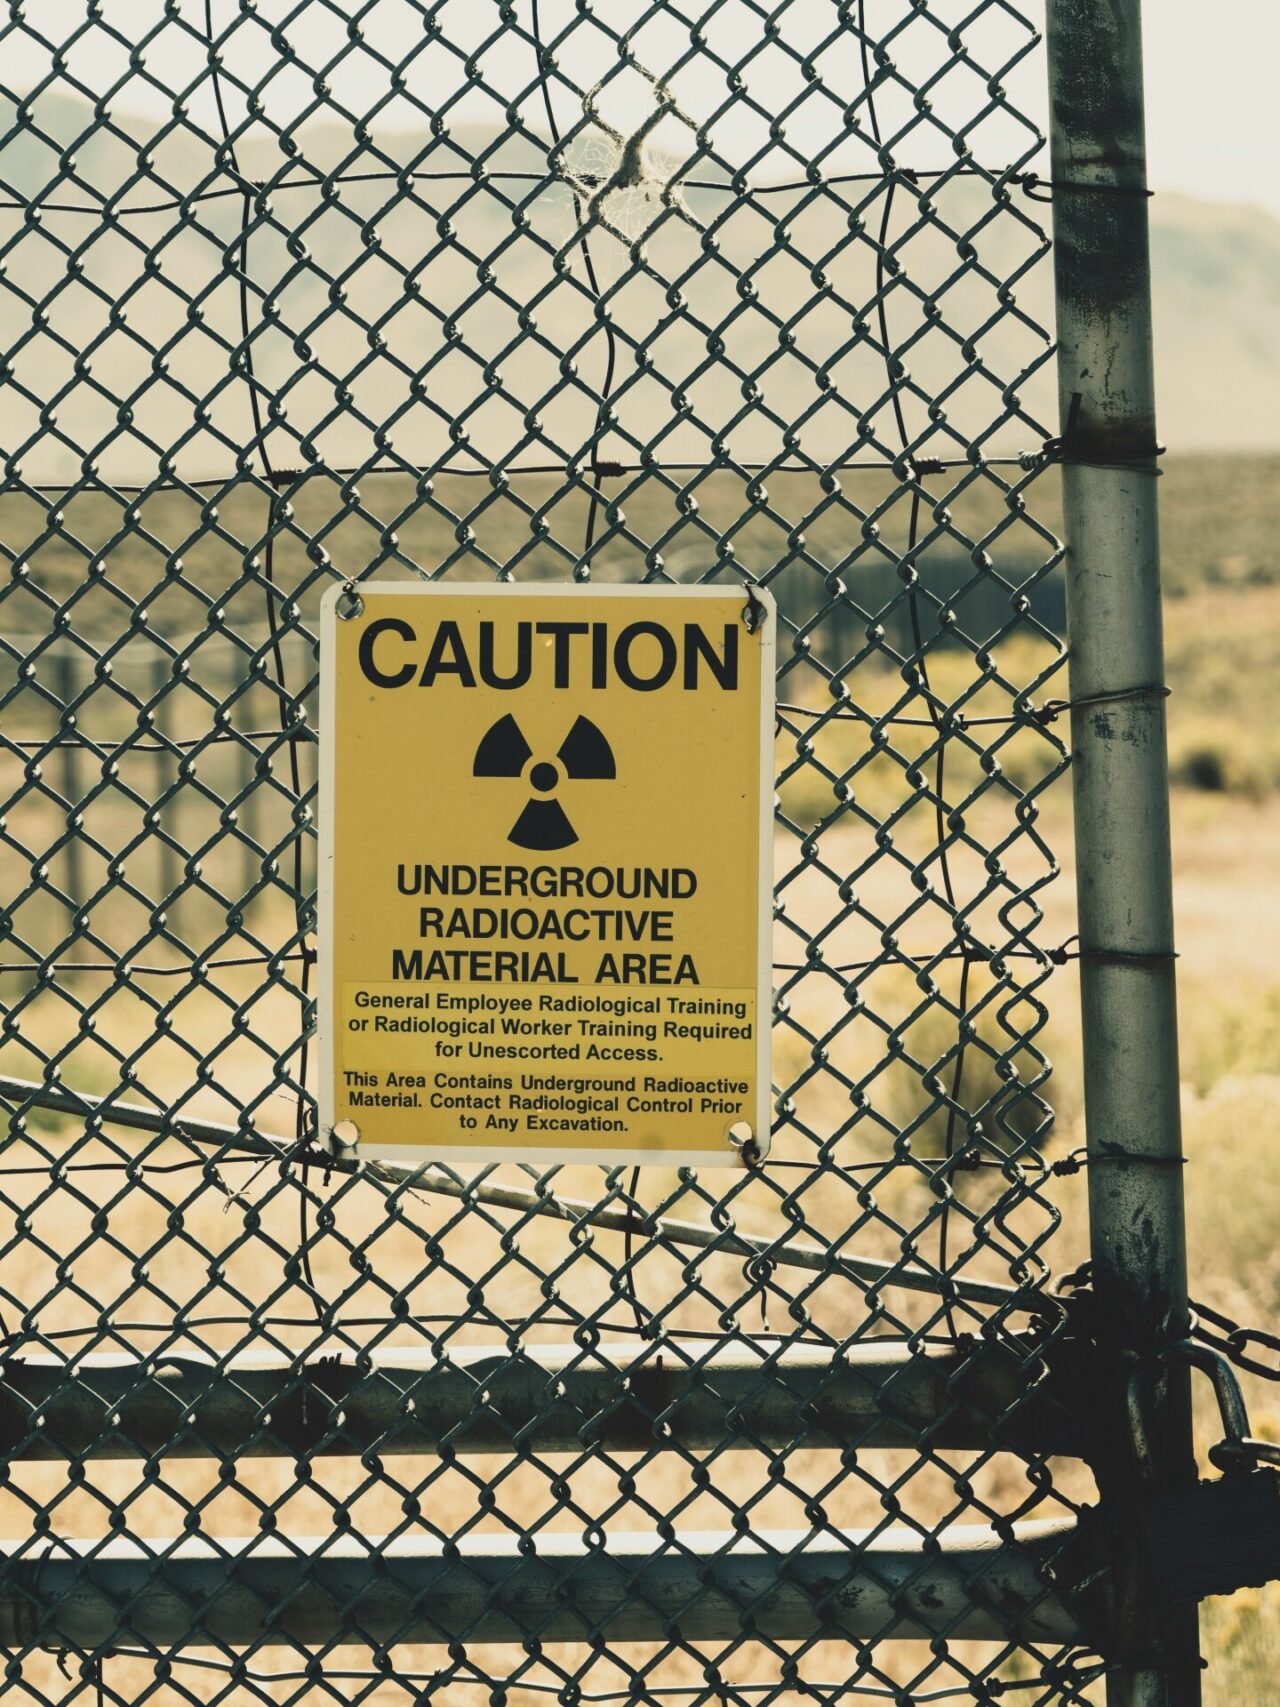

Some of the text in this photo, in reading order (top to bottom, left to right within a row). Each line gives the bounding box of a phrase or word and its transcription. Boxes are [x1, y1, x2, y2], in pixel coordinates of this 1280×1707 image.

[359, 618, 738, 692] CAUTION
[398, 864, 697, 899] UNDERGROUND
[420, 907, 673, 941] RADIOACTIVE
[393, 950, 700, 985] MATERIAL AREA
[355, 991, 746, 1019] General Employee Radiological Training
[349, 1016, 752, 1042] or Radiological Worker Training Required
[435, 1041, 663, 1061] for Unescorted Access.
[343, 1071, 748, 1094] This Area Contains Underground Radioactive
[349, 1091, 742, 1114] Material. Contact Radiological Control Prior
[459, 1114, 628, 1132] to Any Excavation.
